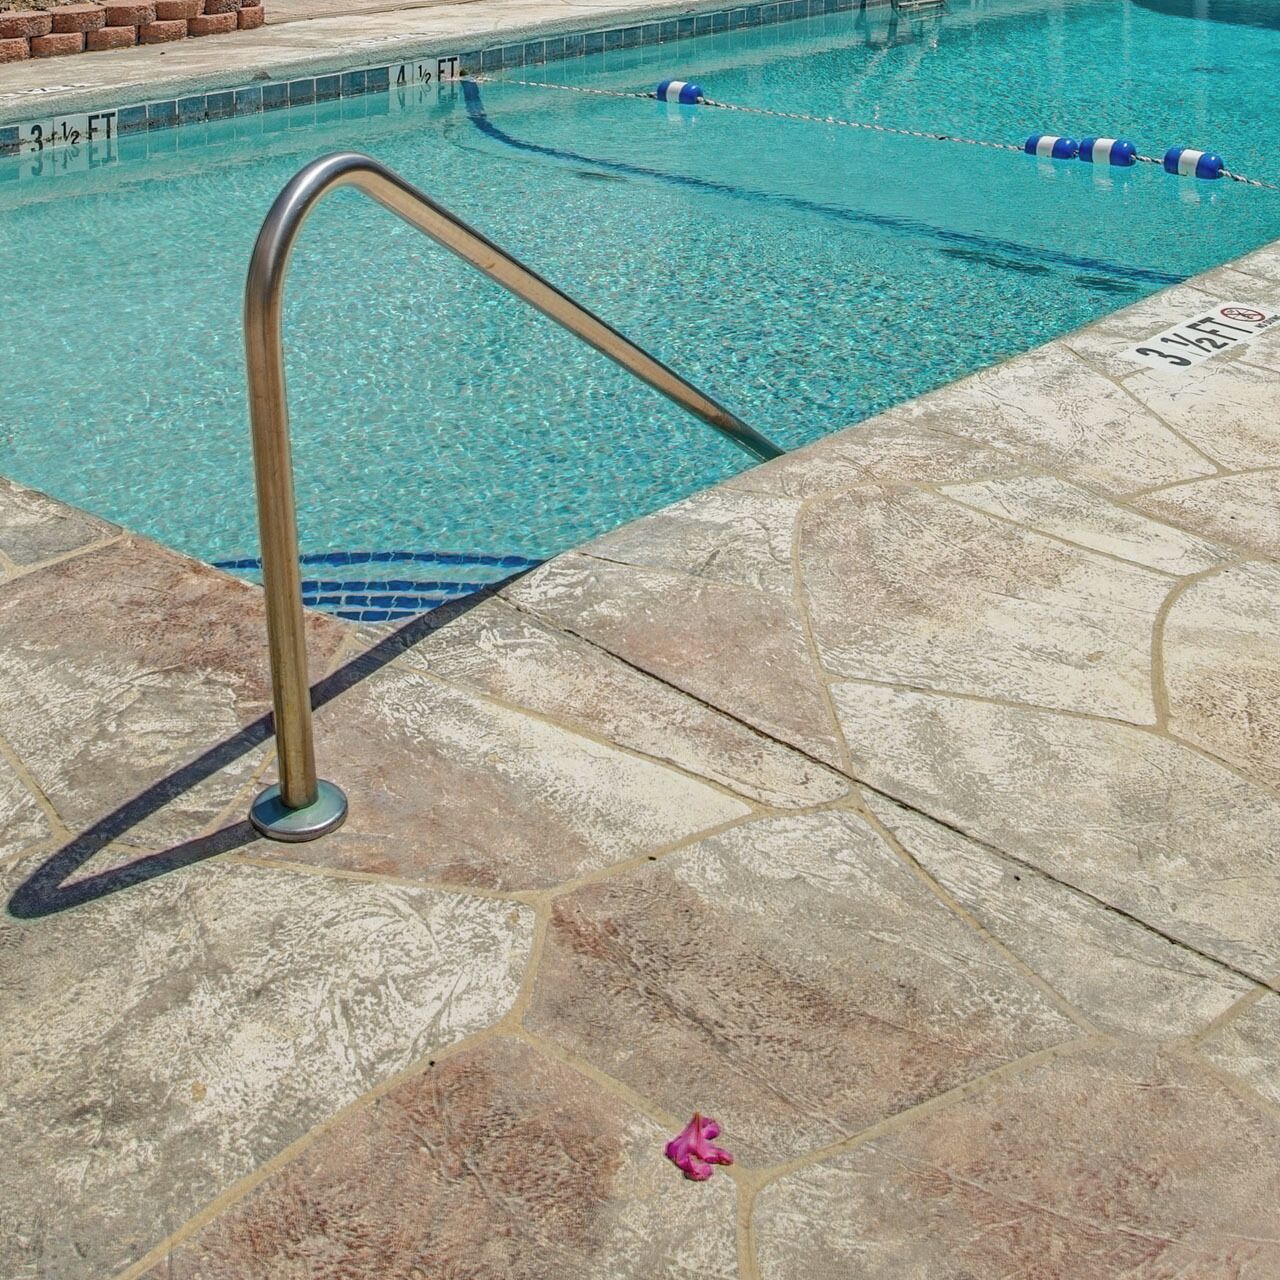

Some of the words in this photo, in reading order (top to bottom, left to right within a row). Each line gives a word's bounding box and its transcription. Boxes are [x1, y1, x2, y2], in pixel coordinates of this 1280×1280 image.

[438, 57, 458, 82] FT
[31, 124, 43, 153] 3
[88, 112, 116, 141] FT
[1136, 347, 1192, 366] 3
